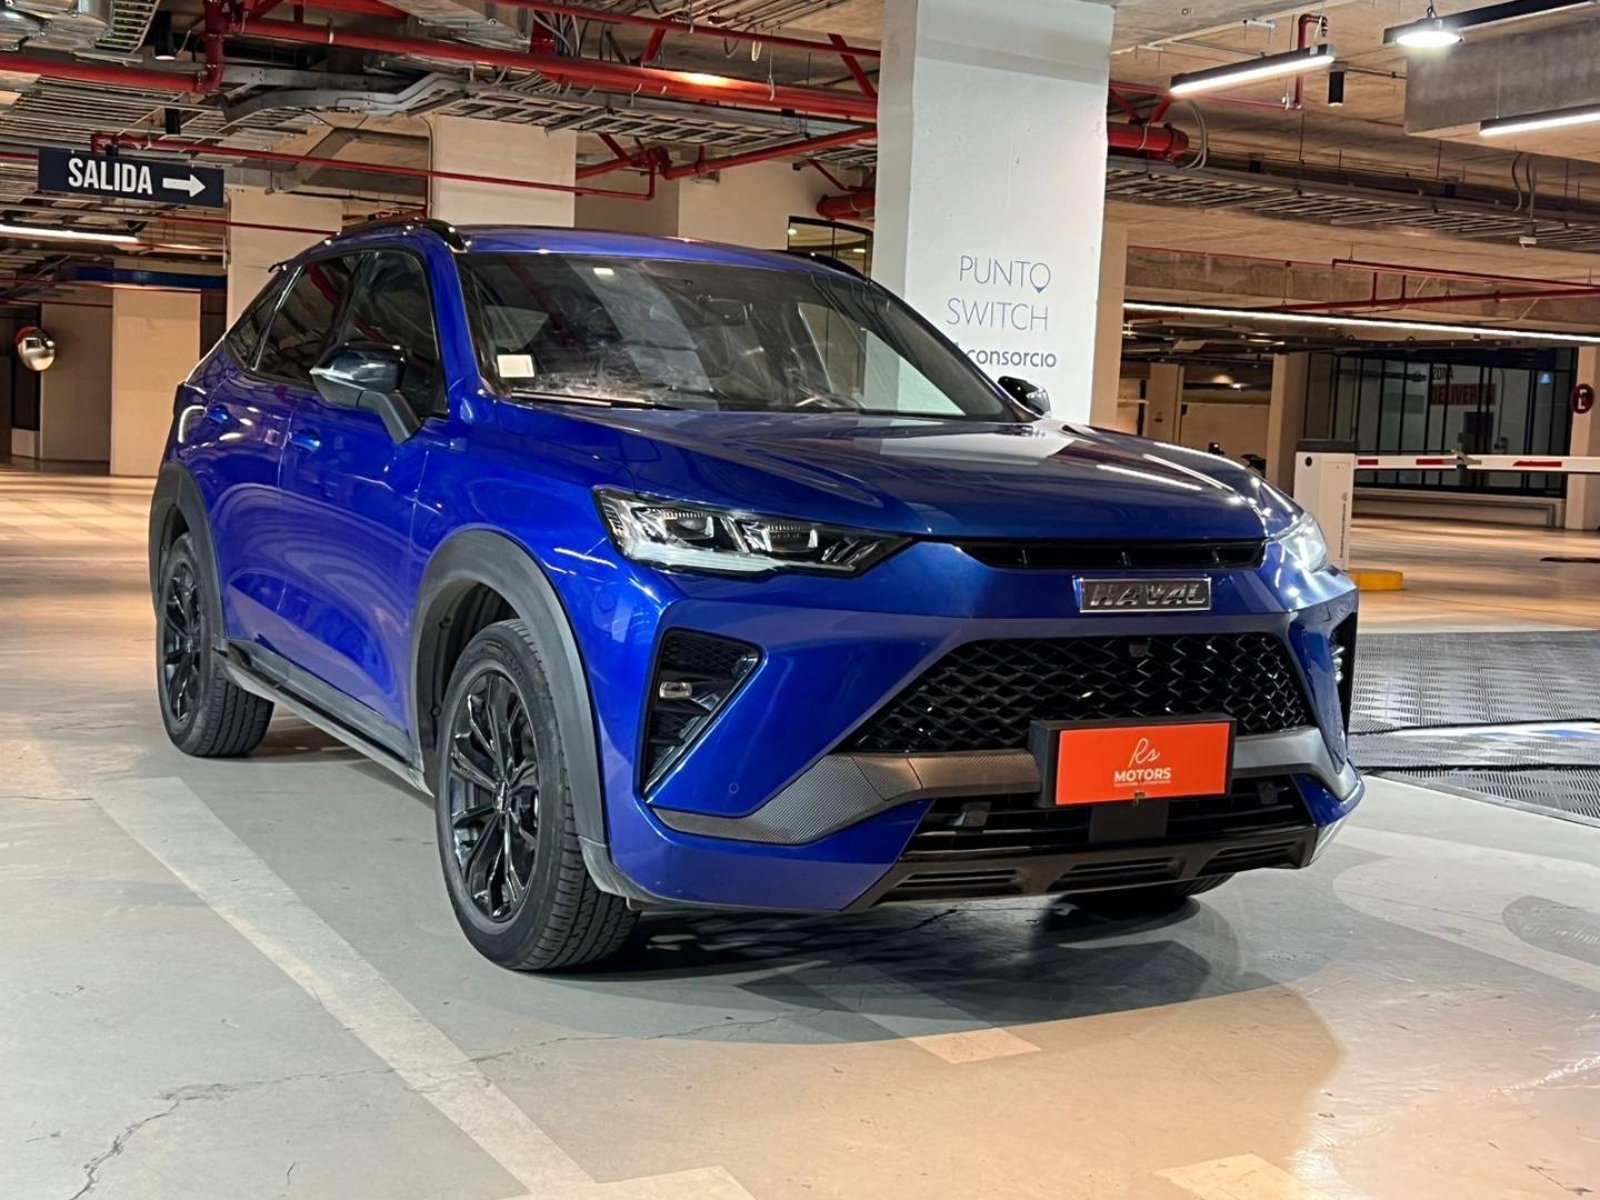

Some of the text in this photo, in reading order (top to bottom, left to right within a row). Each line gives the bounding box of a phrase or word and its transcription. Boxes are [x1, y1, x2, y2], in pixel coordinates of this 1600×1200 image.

[68, 157, 153, 195] SALIDA
[959, 255, 1051, 294] PUNTO
[946, 297, 1049, 331] SWITCH
[1090, 583, 1206, 606] HAVAL
[1113, 767, 1172, 783] MOTORS
